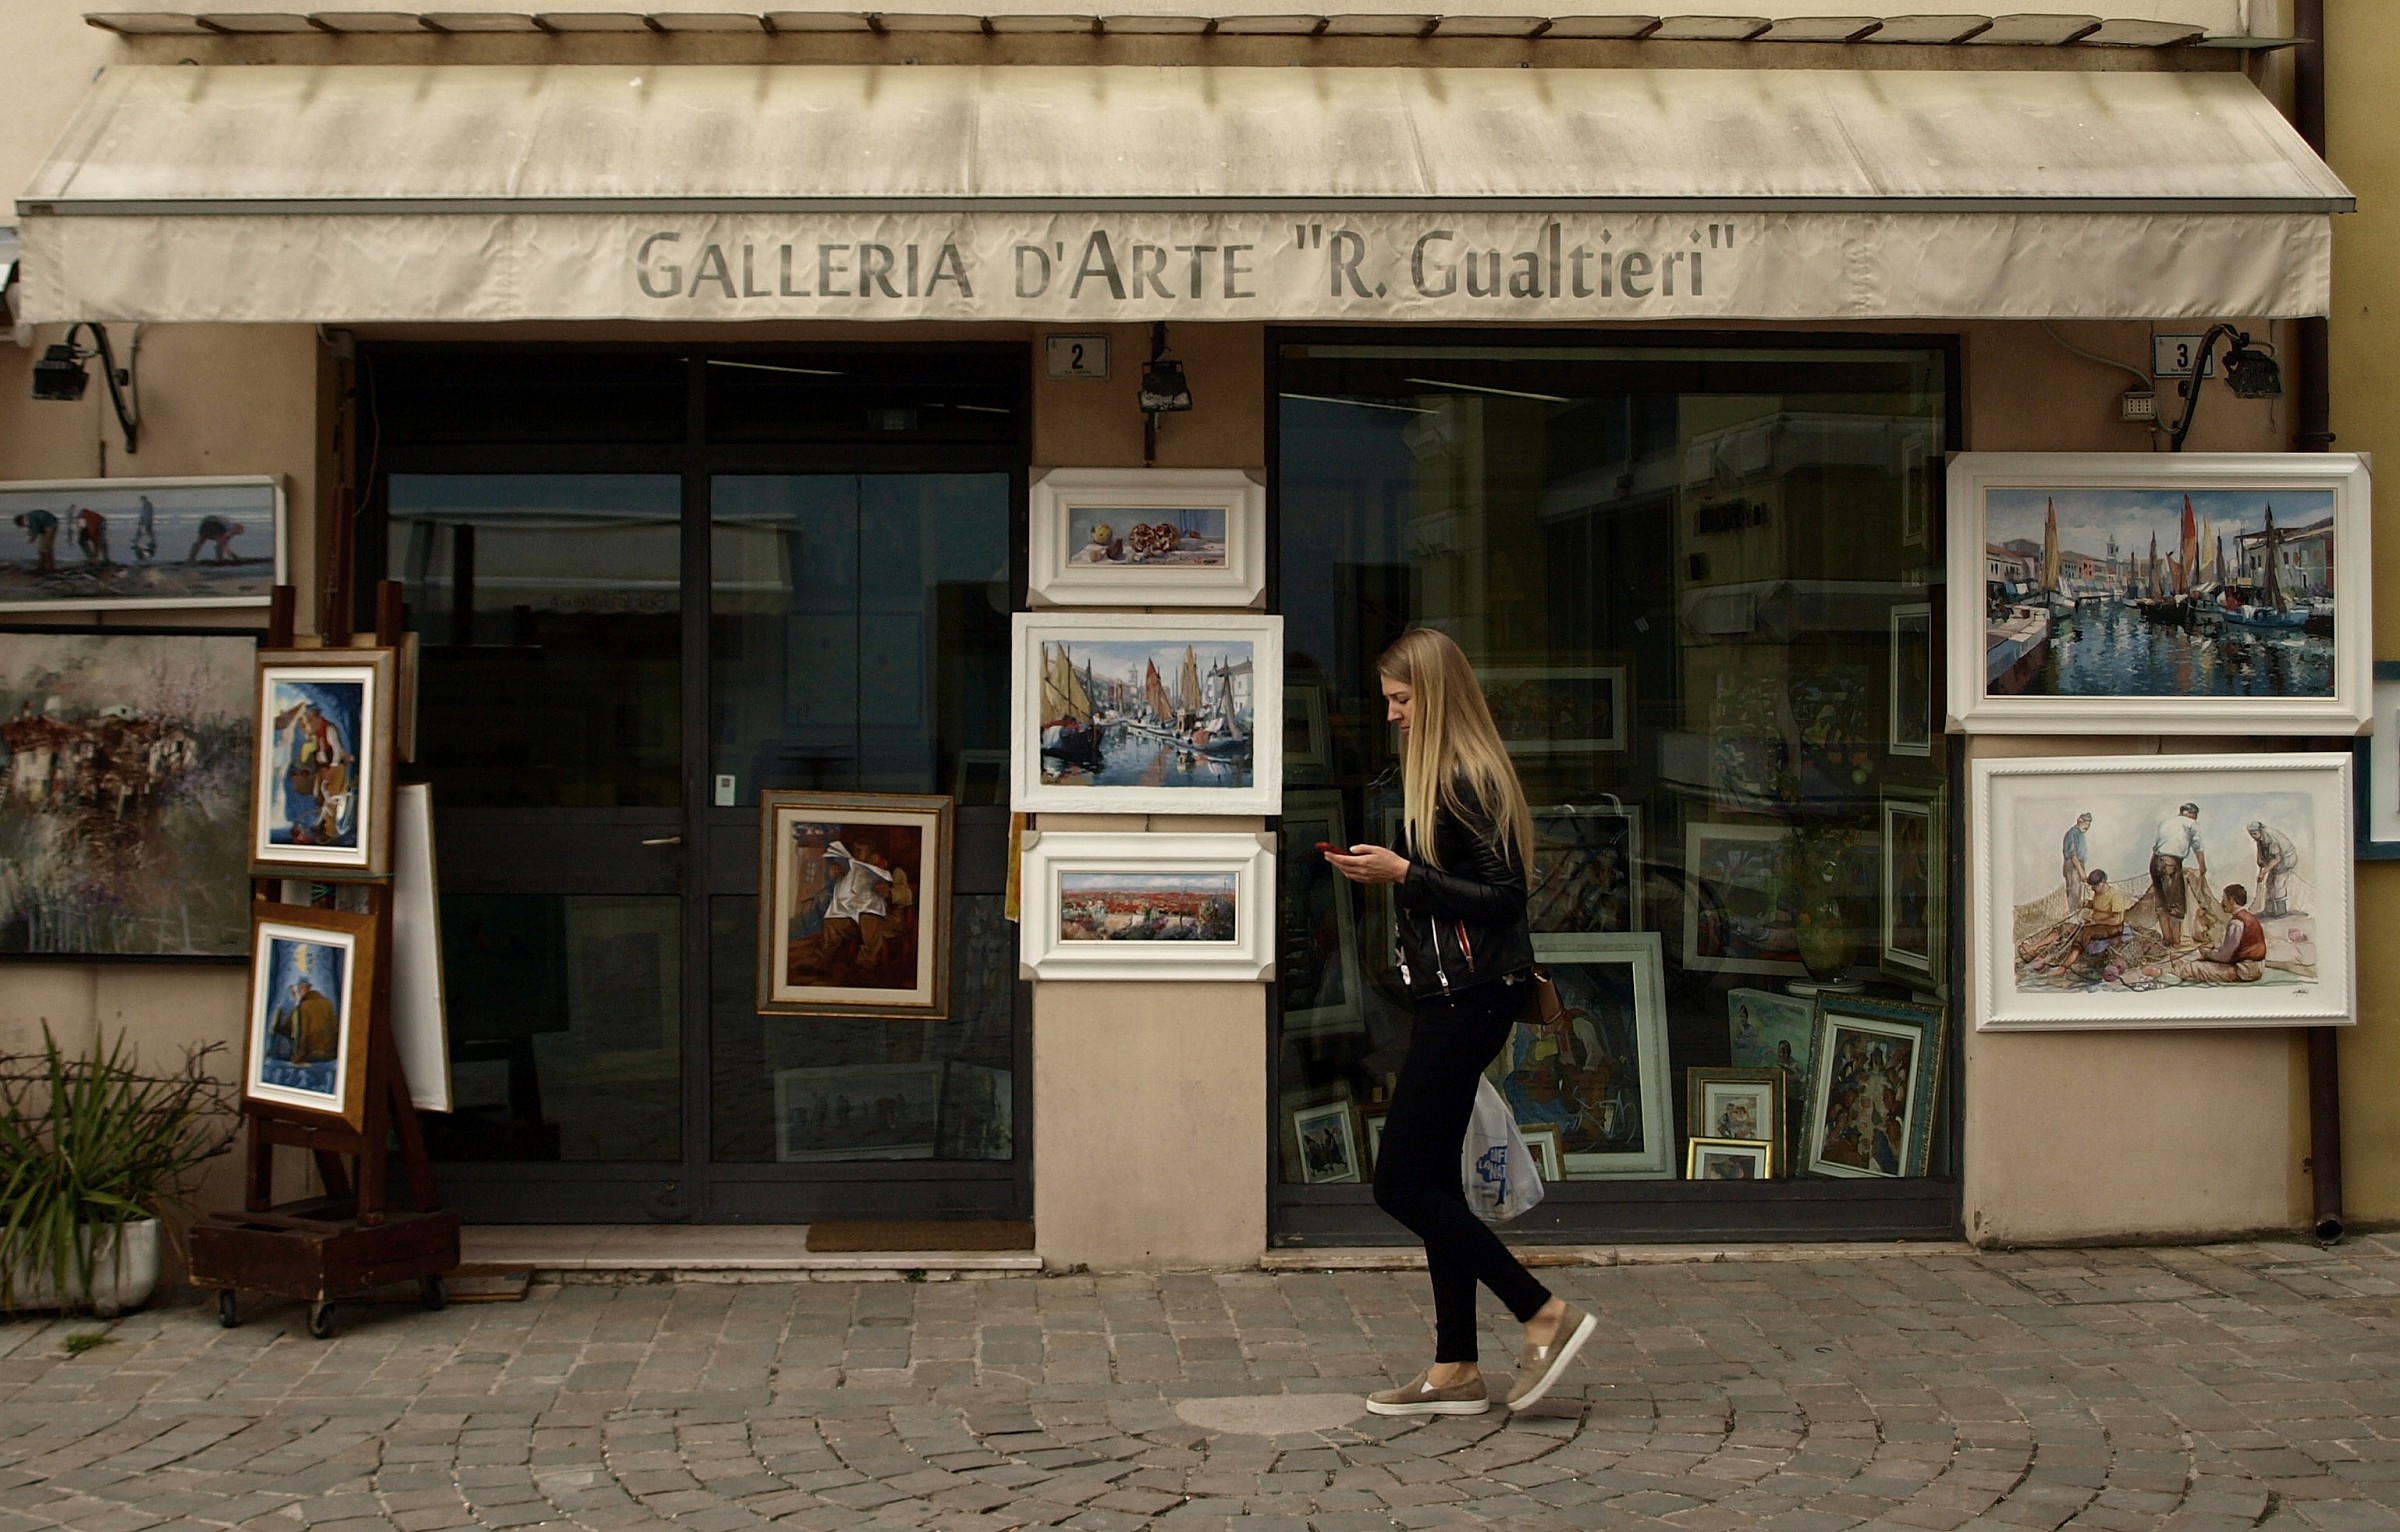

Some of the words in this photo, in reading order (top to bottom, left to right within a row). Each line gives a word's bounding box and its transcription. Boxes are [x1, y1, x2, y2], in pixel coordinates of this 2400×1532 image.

[636, 230, 974, 299] GALLERIA
[1014, 229, 1256, 301] D'ARTE
[1295, 224, 1388, 300] "R.
[1411, 223, 1735, 299] Gualtieri"
[1071, 343, 1083, 369] 2
[2176, 343, 2189, 368] 3
